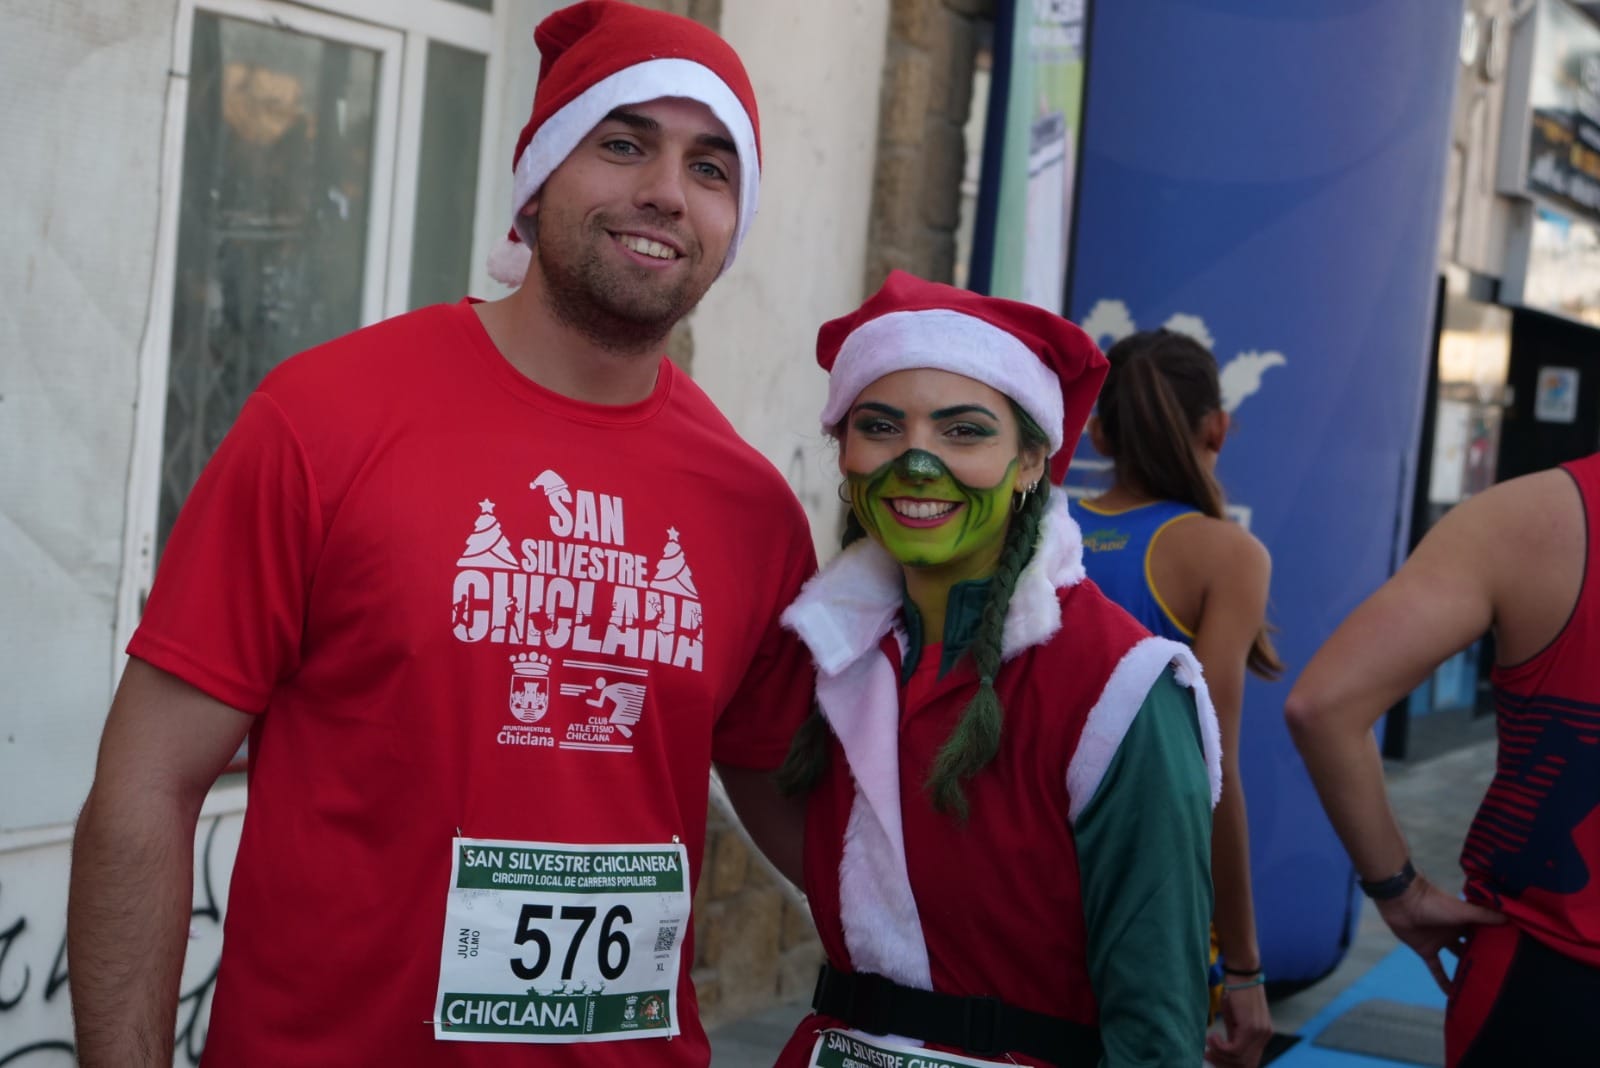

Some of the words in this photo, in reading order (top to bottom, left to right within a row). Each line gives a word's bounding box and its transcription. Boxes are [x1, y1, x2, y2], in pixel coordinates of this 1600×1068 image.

[548, 489, 625, 546] SAN
[521, 538, 648, 589] SILVESTRE
[452, 569, 704, 672] CHICLANA
[568, 723, 614, 734] ATLETISMO
[588, 716, 608, 725] CLUB
[497, 731, 554, 747] Chiclana
[566, 732, 610, 742] CHICLANA
[465, 851, 503, 868] SAN
[508, 852, 590, 872] SILVESTRE
[593, 855, 678, 873] CHICLANERA
[492, 872, 534, 885] CIRCUITO
[535, 874, 562, 886] LOCAL
[565, 875, 577, 887] DE
[578, 876, 616, 887] CARRERAS
[617, 875, 656, 887] POPULARES
[457, 928, 470, 959] JUAN
[470, 930, 480, 957] OLMO
[510, 904, 633, 980] 576
[446, 999, 579, 1028] CHICLANA
[828, 1033, 851, 1055] SAN
[853, 1041, 904, 1068] SILVESTRE
